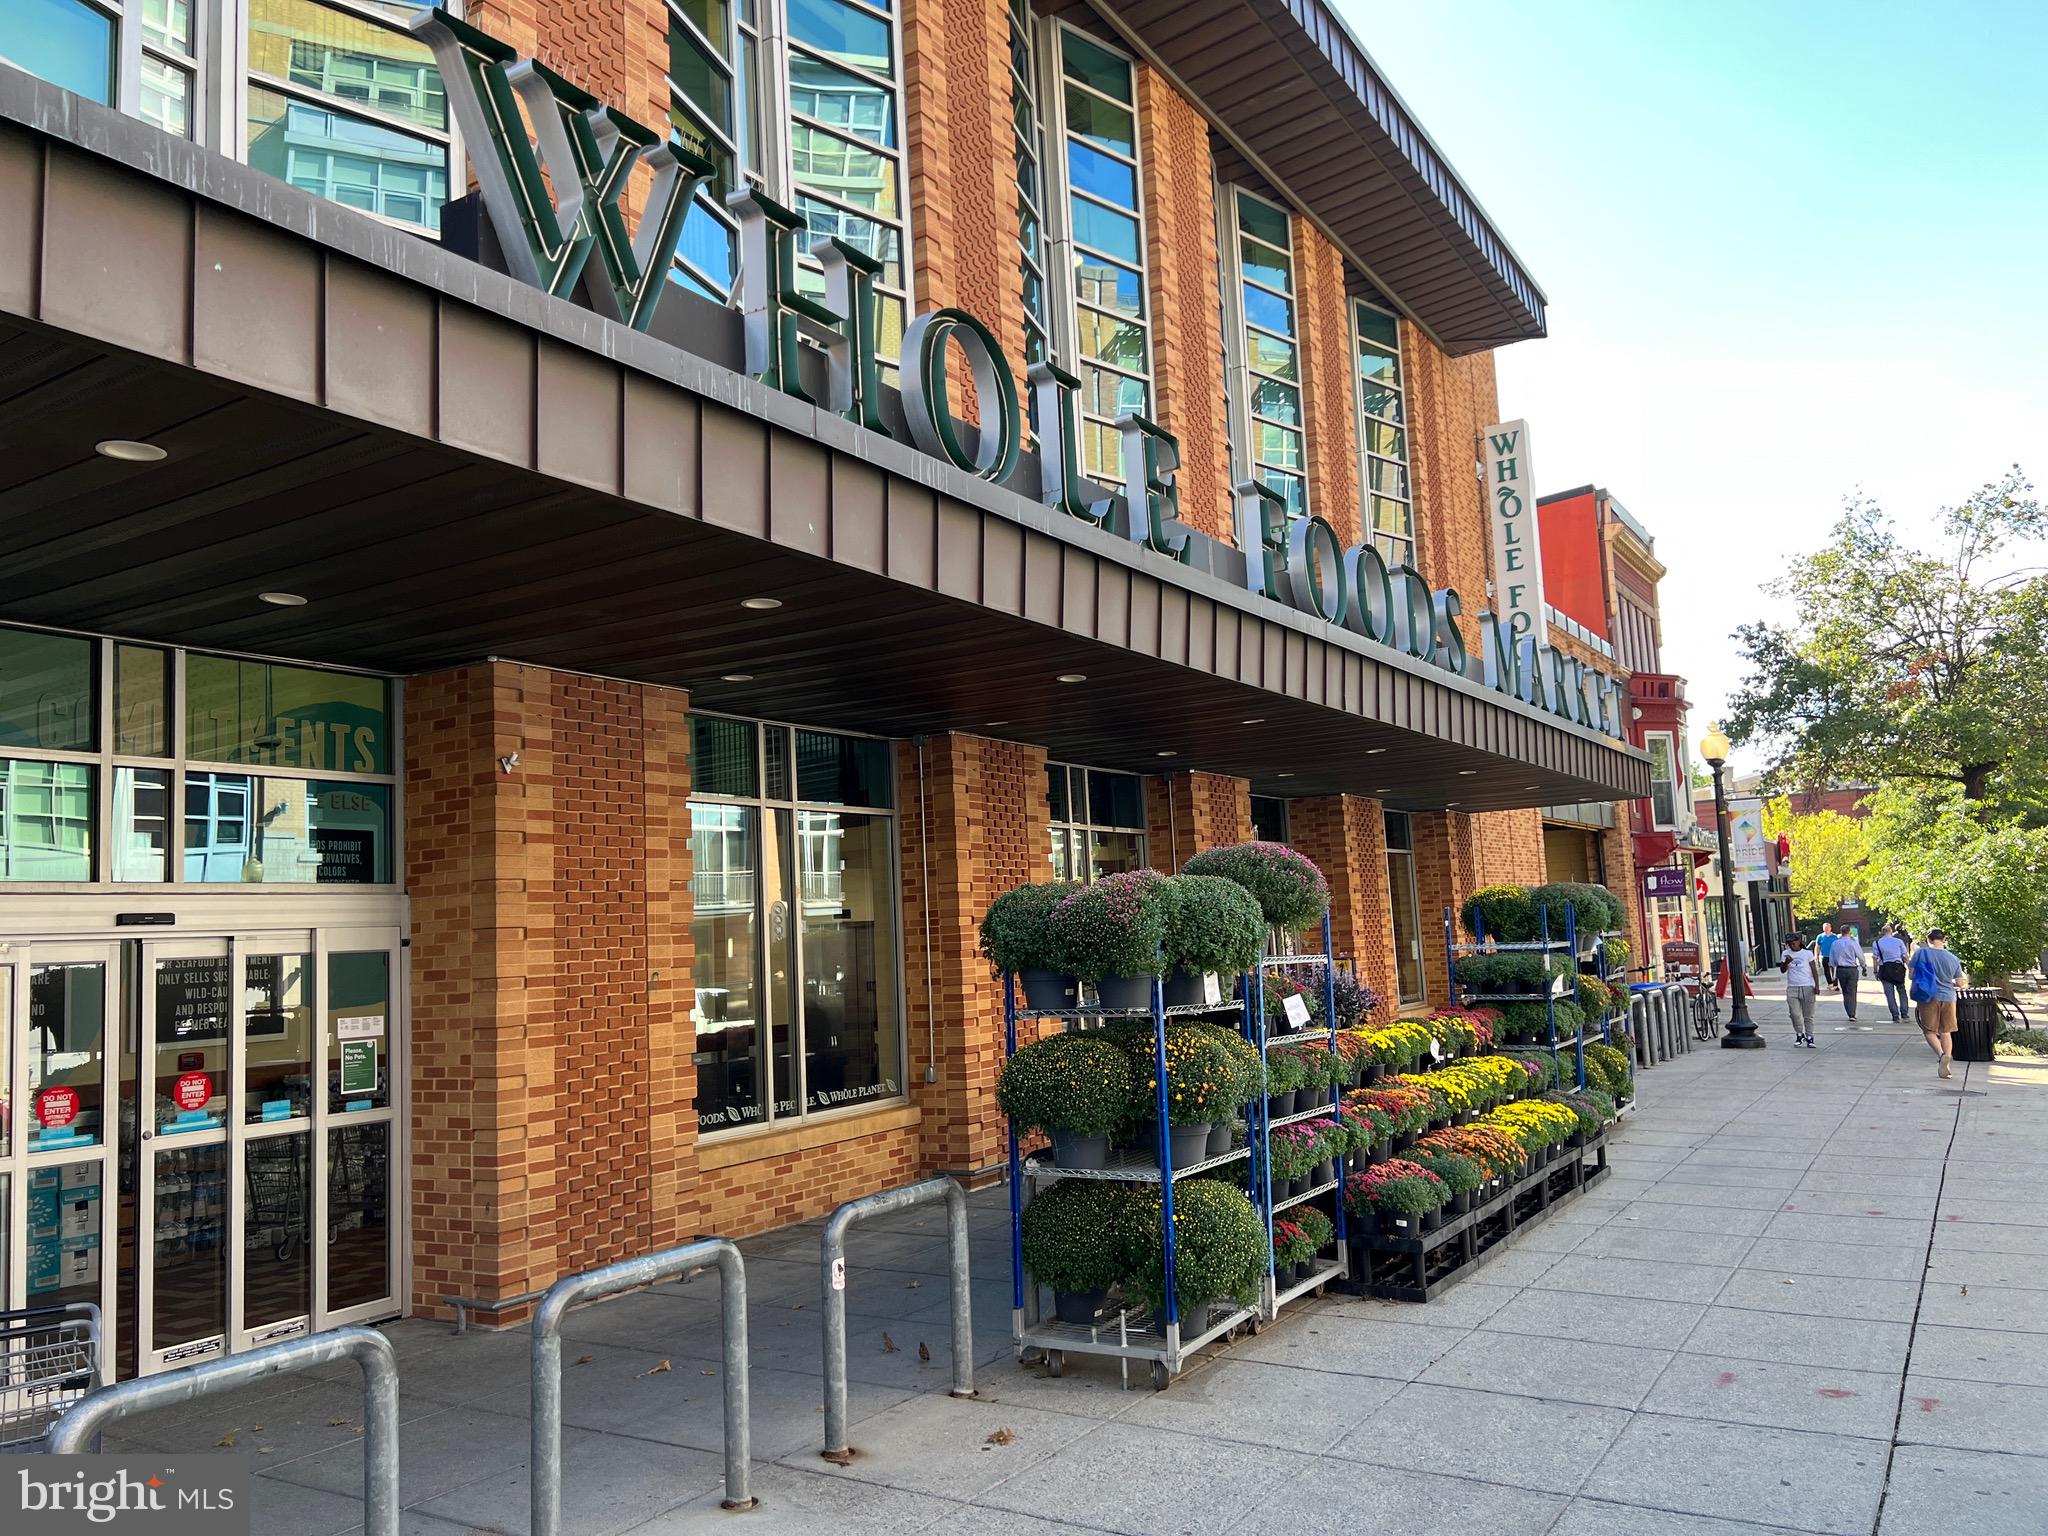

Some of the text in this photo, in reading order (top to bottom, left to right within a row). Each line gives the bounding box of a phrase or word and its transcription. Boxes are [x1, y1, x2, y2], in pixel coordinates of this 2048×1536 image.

[408, 8, 1626, 742] WHOLE FOODS MARKET
[1488, 429, 1525, 573] WHOLE
[328, 840, 363, 852] PROHIBIT
[1736, 847, 1764, 856] PRIDE
[321, 853, 363, 865] ERVATIVES,
[318, 866, 347, 877] COLORS
[1660, 874, 1683, 885] flow
[158, 973, 181, 985] ONLY
[183, 971, 210, 984] SELLS
[175, 1003, 194, 1016] AND
[56, 1093, 73, 1101] NOT
[181, 1091, 206, 1099] ENTER
[829, 1088, 858, 1103] WHOLE
[44, 1107, 71, 1115] ENTER
